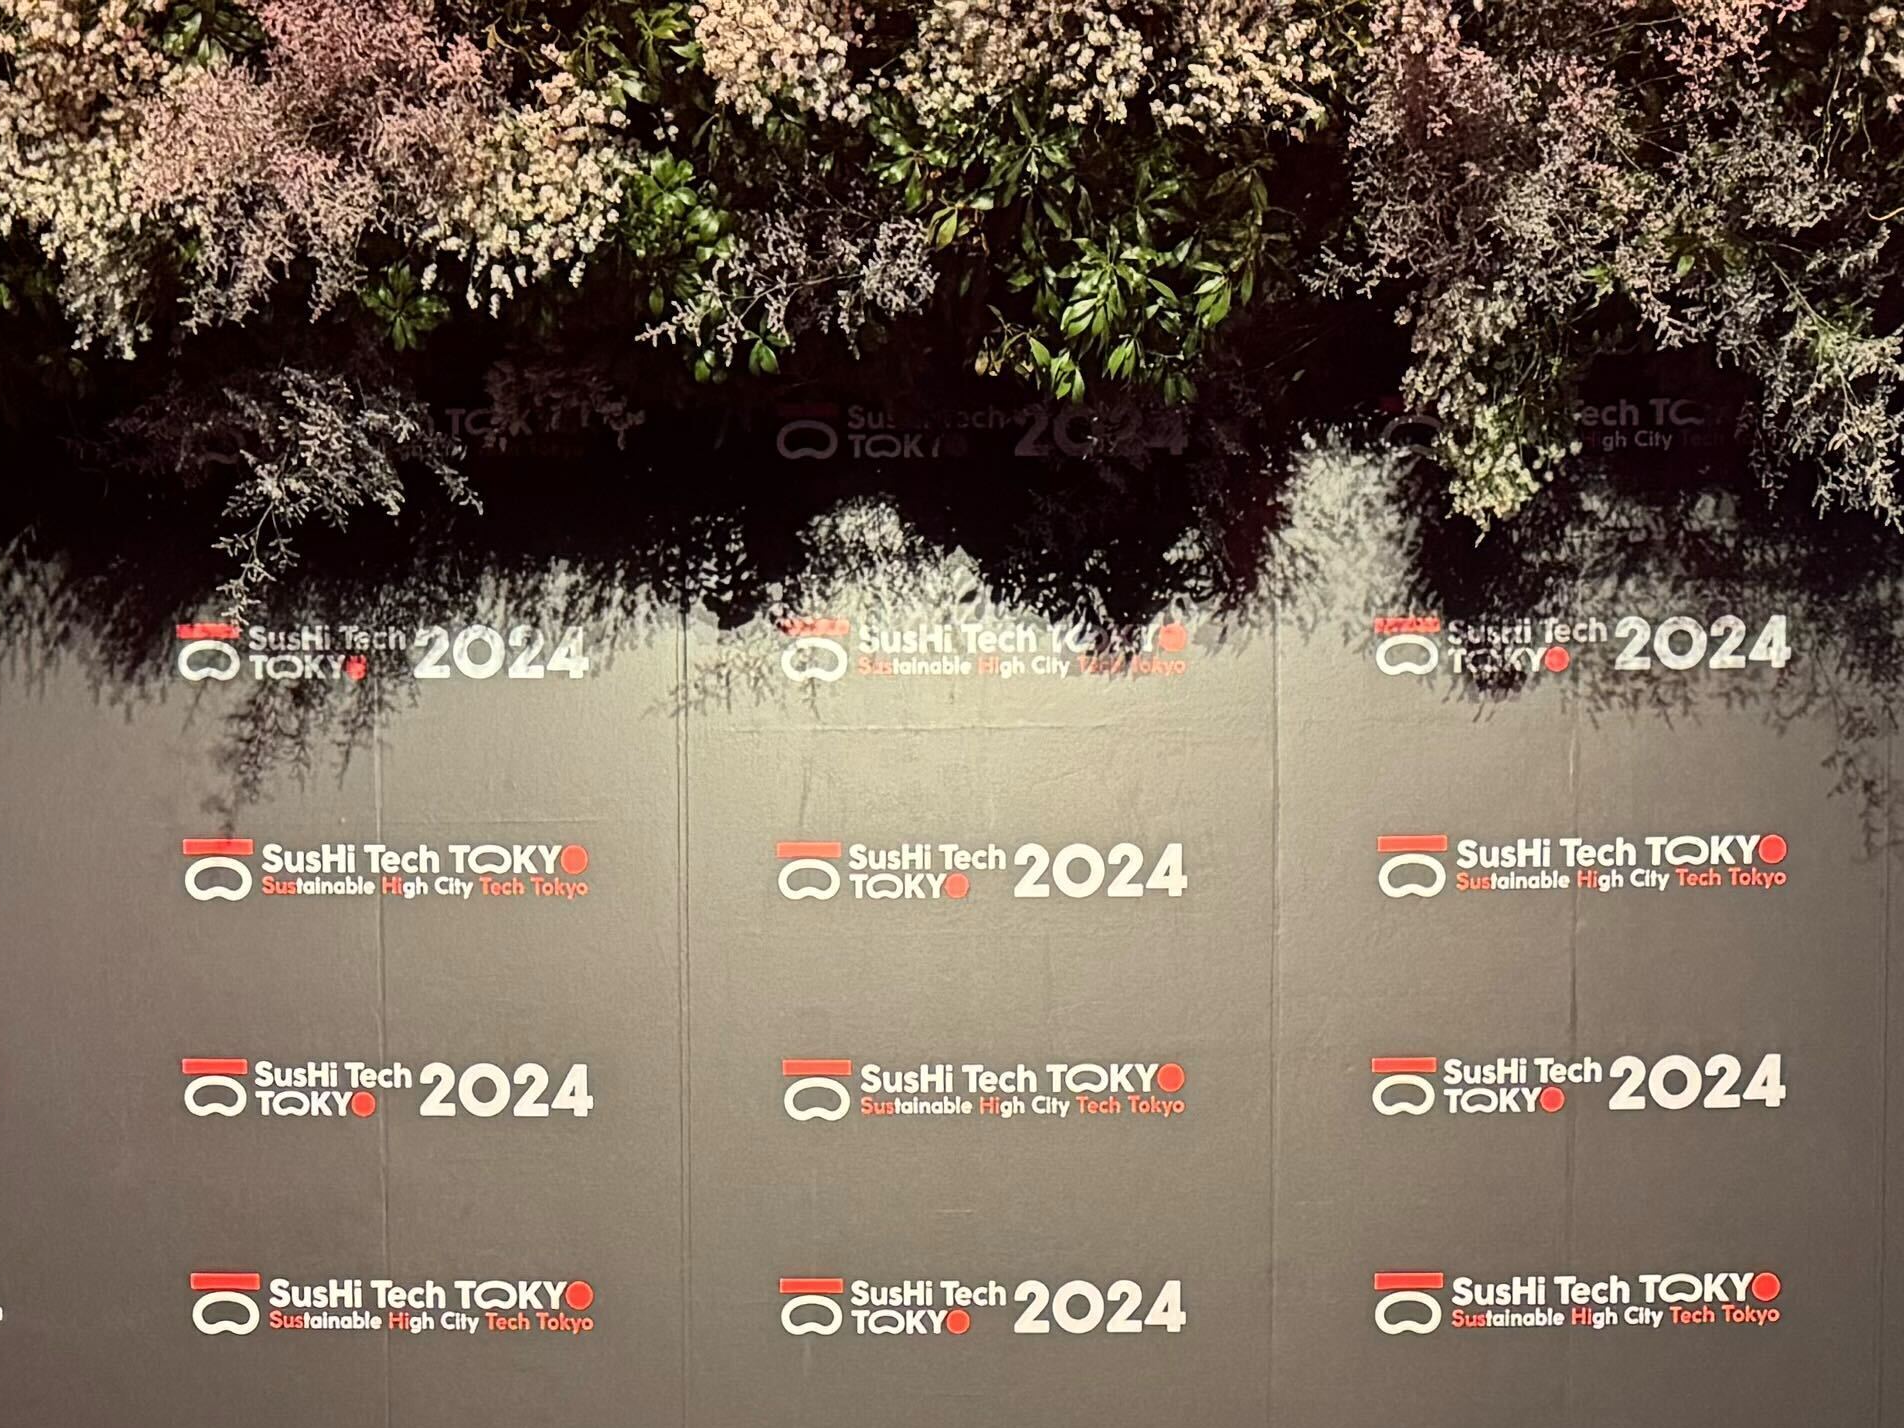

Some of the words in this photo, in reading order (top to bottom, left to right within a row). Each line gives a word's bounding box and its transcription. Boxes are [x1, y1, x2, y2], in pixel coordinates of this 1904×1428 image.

[262, 844, 355, 873] SusHi
[364, 845, 439, 873] Tech
[449, 844, 589, 874] TOKYO
[849, 843, 931, 870] SusHi
[938, 844, 1006, 870] Tech
[1014, 843, 1187, 898] 2024
[262, 876, 375, 894] Sustainable
[383, 876, 428, 899] High
[435, 877, 473, 899] City
[479, 877, 525, 896] Tech
[530, 877, 588, 899] Tokyo
[849, 873, 969, 899] TOKYO
[861, 1064, 953, 1093] SusHi
[962, 1064, 1037, 1093] Tech
[1046, 1063, 1185, 1092] TOKYO
[861, 1096, 972, 1114] Sustainable
[980, 1096, 1025, 1118] High
[1032, 1096, 1070, 1117] City
[1076, 1096, 1120, 1113] Tech
[1128, 1095, 1184, 1117] Tokyo
[1452, 1277, 1545, 1306] SusHi
[1554, 1275, 1630, 1304] Tech
[1639, 1273, 1780, 1303] TOKYO
[1452, 1307, 1564, 1327] Sustainable
[1571, 1306, 1618, 1329] High
[1626, 1305, 1664, 1328] City
[1670, 1305, 1715, 1323] Tech
[1722, 1304, 1780, 1325] Tokyo
